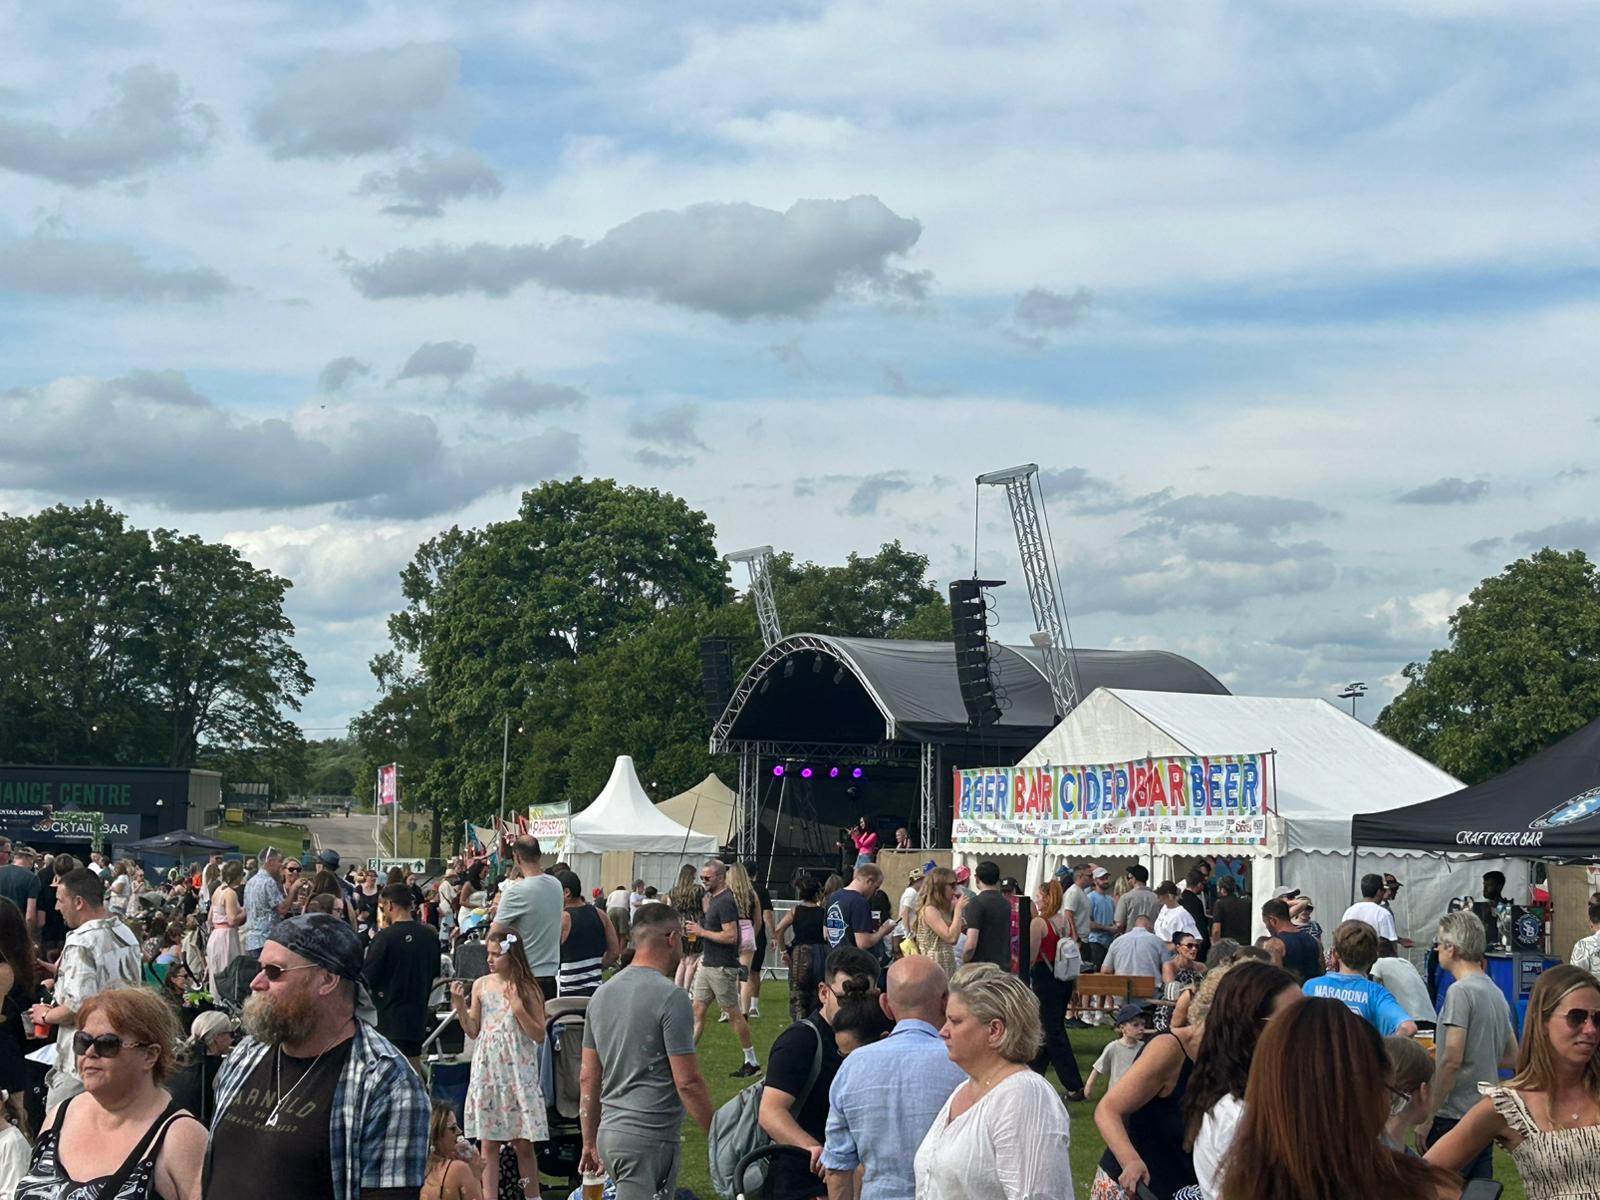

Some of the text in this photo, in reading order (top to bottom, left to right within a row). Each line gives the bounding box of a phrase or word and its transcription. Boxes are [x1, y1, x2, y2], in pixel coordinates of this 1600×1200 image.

[0, 782, 131, 805] ANCE CENTRE
[962, 763, 1257, 814] BEER BAR CIDER BAR BEER
[19, 809, 44, 817] GARDEN
[100, 823, 128, 835] BAR
[1456, 831, 1543, 846] CRAFT BEER BAR
[1314, 985, 1369, 1004] MARADONA
